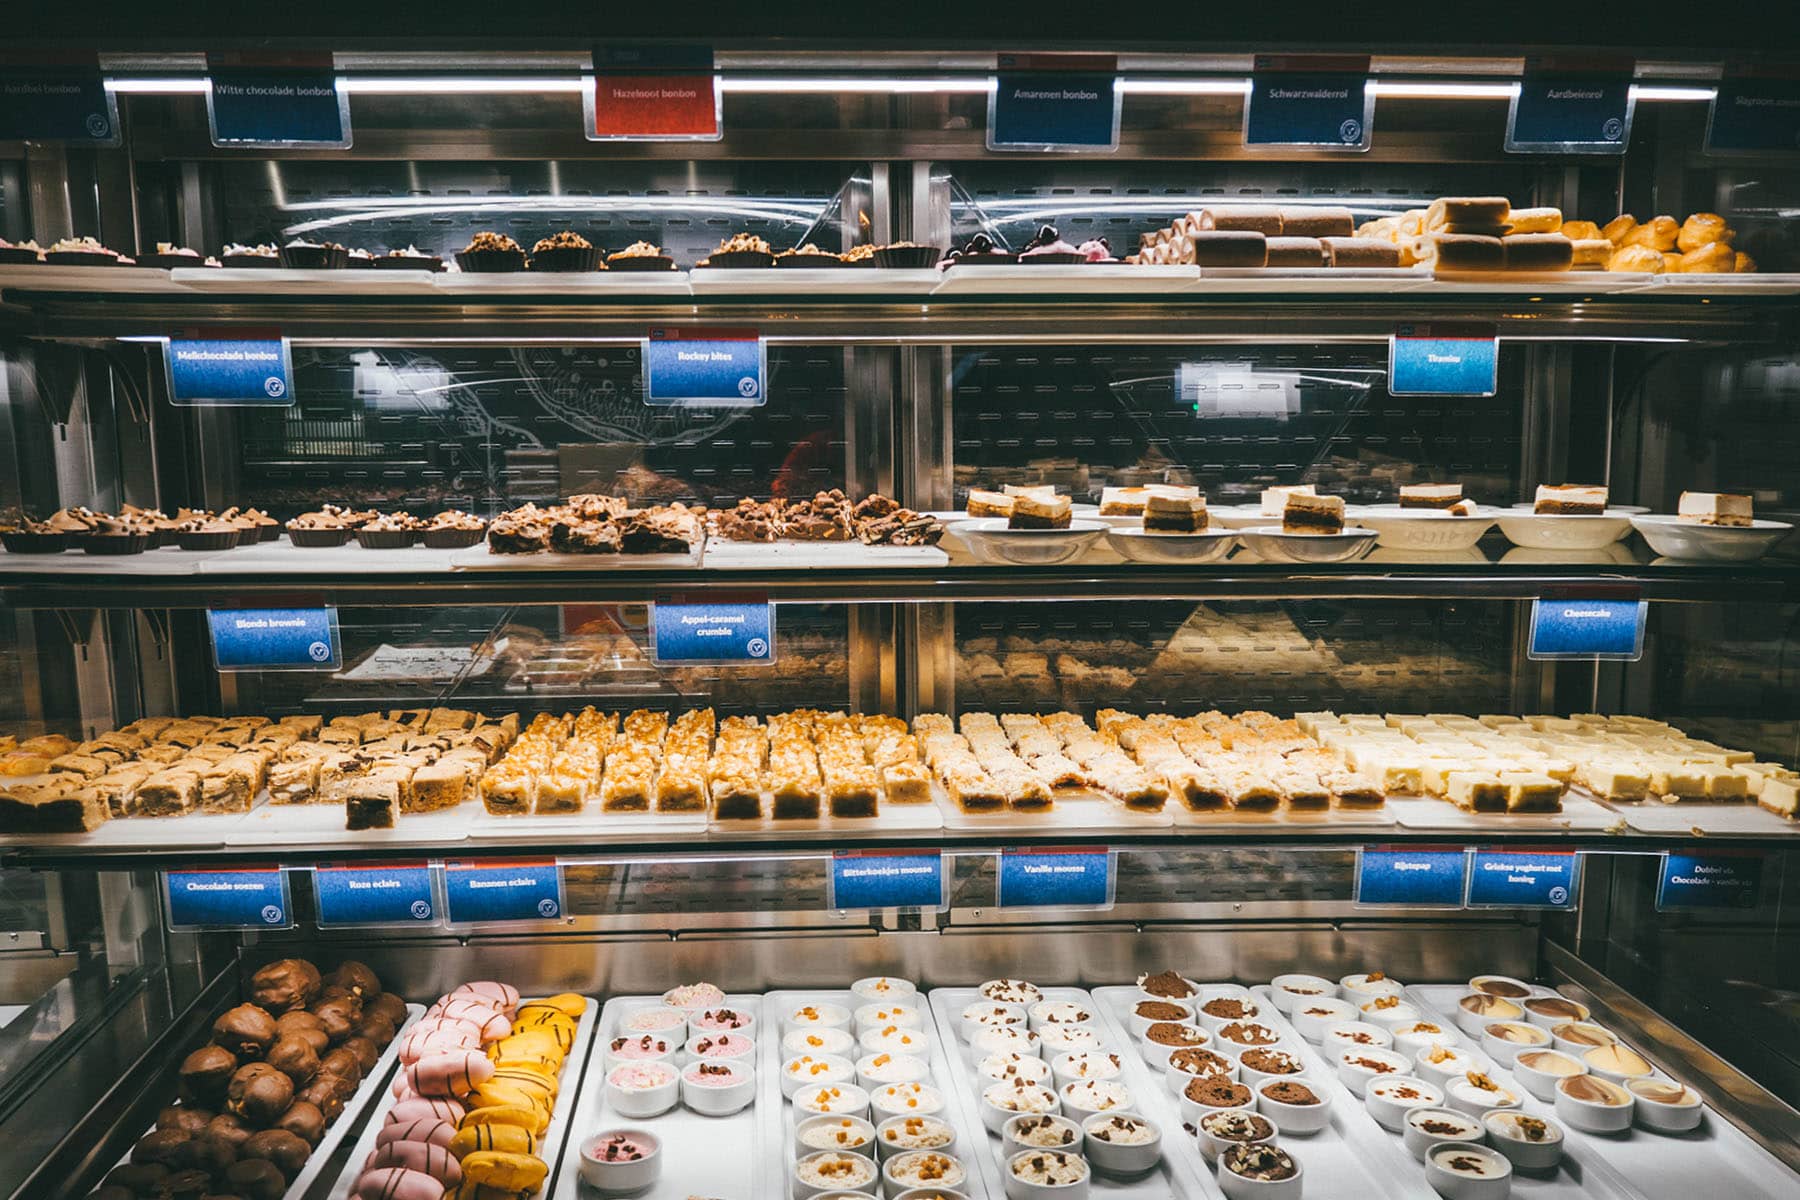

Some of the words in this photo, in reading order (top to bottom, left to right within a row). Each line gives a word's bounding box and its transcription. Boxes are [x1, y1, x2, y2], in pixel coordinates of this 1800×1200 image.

[215, 84, 243, 95] Witte
[246, 85, 294, 96] chocolade
[297, 87, 333, 96] bonbon
[613, 89, 660, 98] Hazelnoot
[661, 89, 697, 98] bonbon
[1013, 89, 1061, 99] Amarenen
[1062, 89, 1098, 99] bonbon
[245, 351, 278, 361] bonbon
[678, 351, 710, 362] Rockey
[711, 351, 733, 361] bites
[1563, 608, 1612, 618] Cheesecake
[235, 619, 268, 629] Blonde
[269, 617, 306, 627] brownie
[681, 614, 745, 625] Appel-caramel
[696, 627, 733, 636] crumble
[900, 866, 933, 875] mousse
[1023, 864, 1053, 873] Vanille
[1054, 865, 1086, 873] mousse
[1515, 863, 1545, 873] yoghurt
[1546, 864, 1562, 873] met
[1694, 865, 1722, 874] Dubbel
[349, 880, 371, 889] Roze
[372, 879, 401, 888] eclairs
[469, 880, 508, 889] Bananen
[508, 877, 537, 887] eclairs
[1671, 875, 1710, 885] Chocolade
[186, 882, 233, 891] Chocolade
